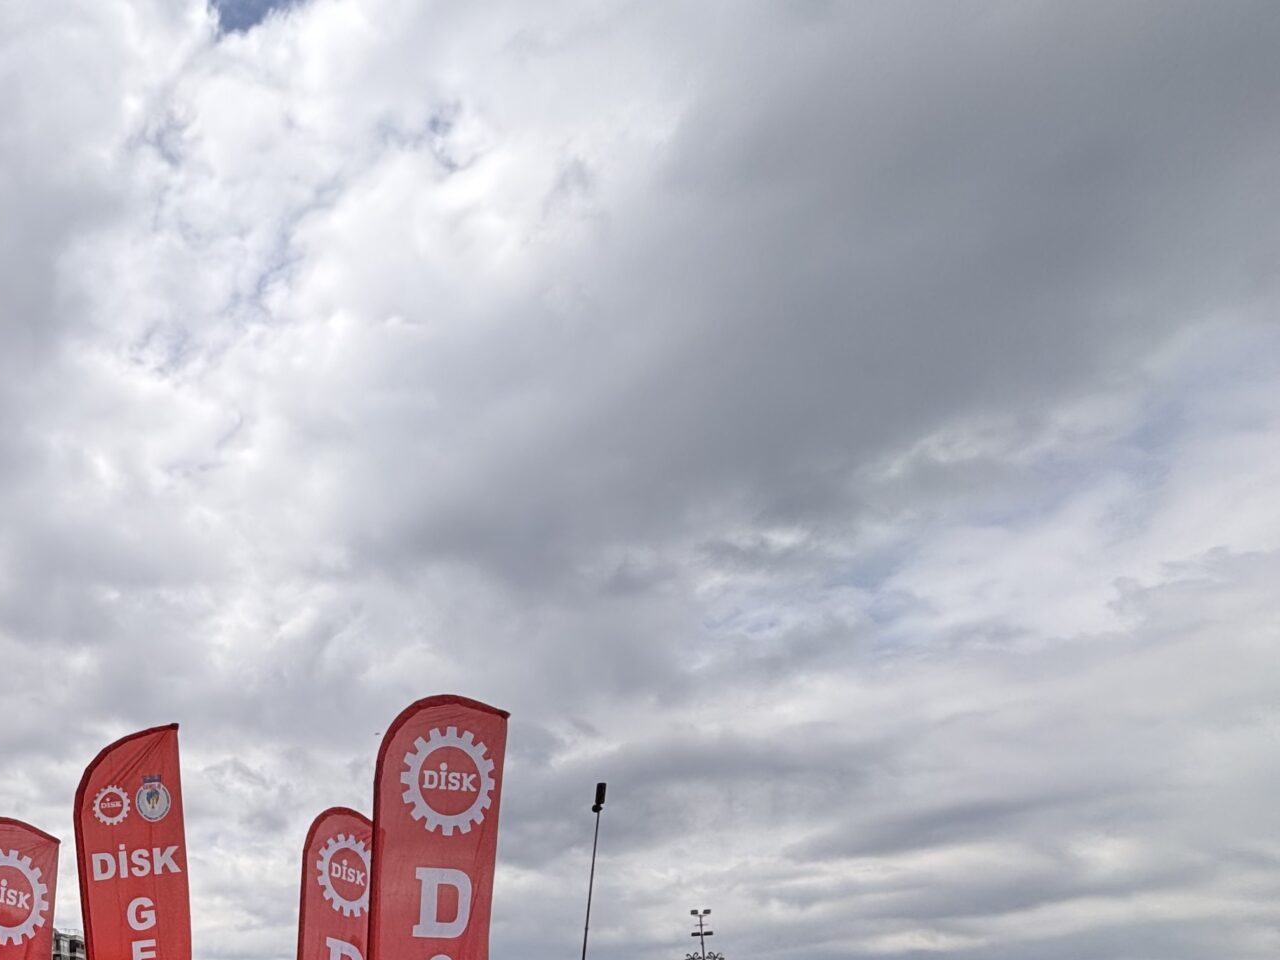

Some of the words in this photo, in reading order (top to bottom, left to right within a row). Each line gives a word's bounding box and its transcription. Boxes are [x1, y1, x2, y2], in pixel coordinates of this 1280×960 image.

[423, 762, 477, 792] DİSK
[91, 843, 182, 881] DİSK
[330, 858, 366, 887] DİSK
